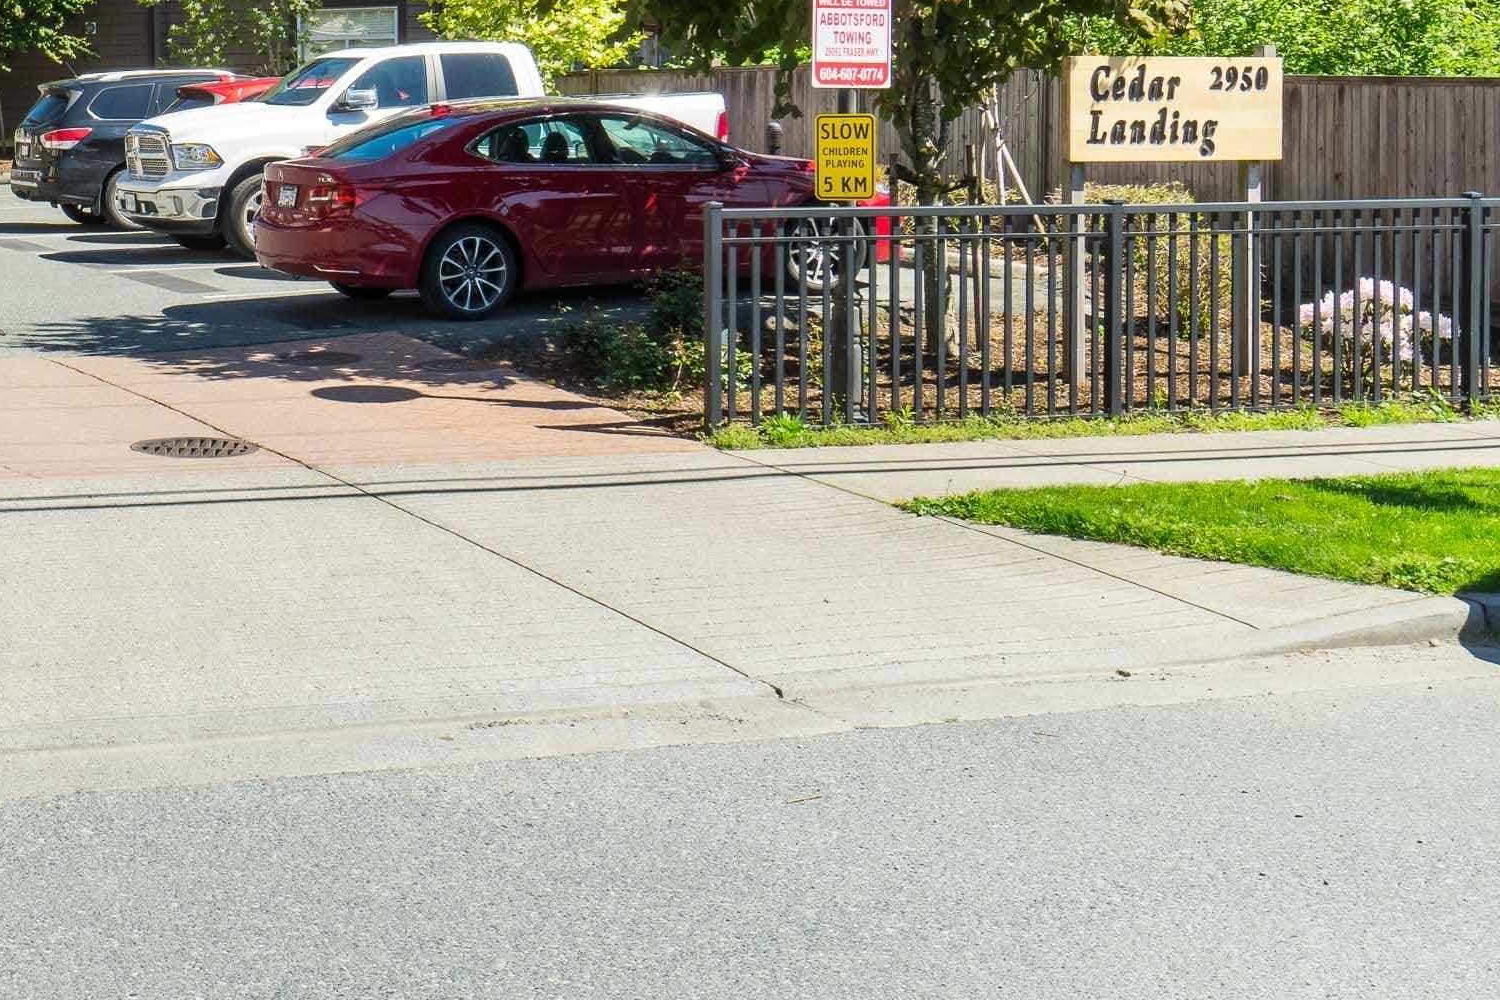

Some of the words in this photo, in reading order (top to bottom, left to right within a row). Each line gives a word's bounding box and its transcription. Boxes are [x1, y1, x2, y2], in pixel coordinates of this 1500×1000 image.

[820, 12, 885, 27] ABBOTSFORD
[833, 31, 871, 44] TOWING
[1090, 63, 1181, 102] Cedar
[1208, 65, 1269, 92] 2950
[820, 123, 869, 139] SLOW
[1086, 107, 1219, 157] Landing
[822, 147, 868, 156] CHILDREN
[825, 159, 865, 168] PLAYING
[824, 177, 833, 192] 5
[841, 177, 867, 192] KM
